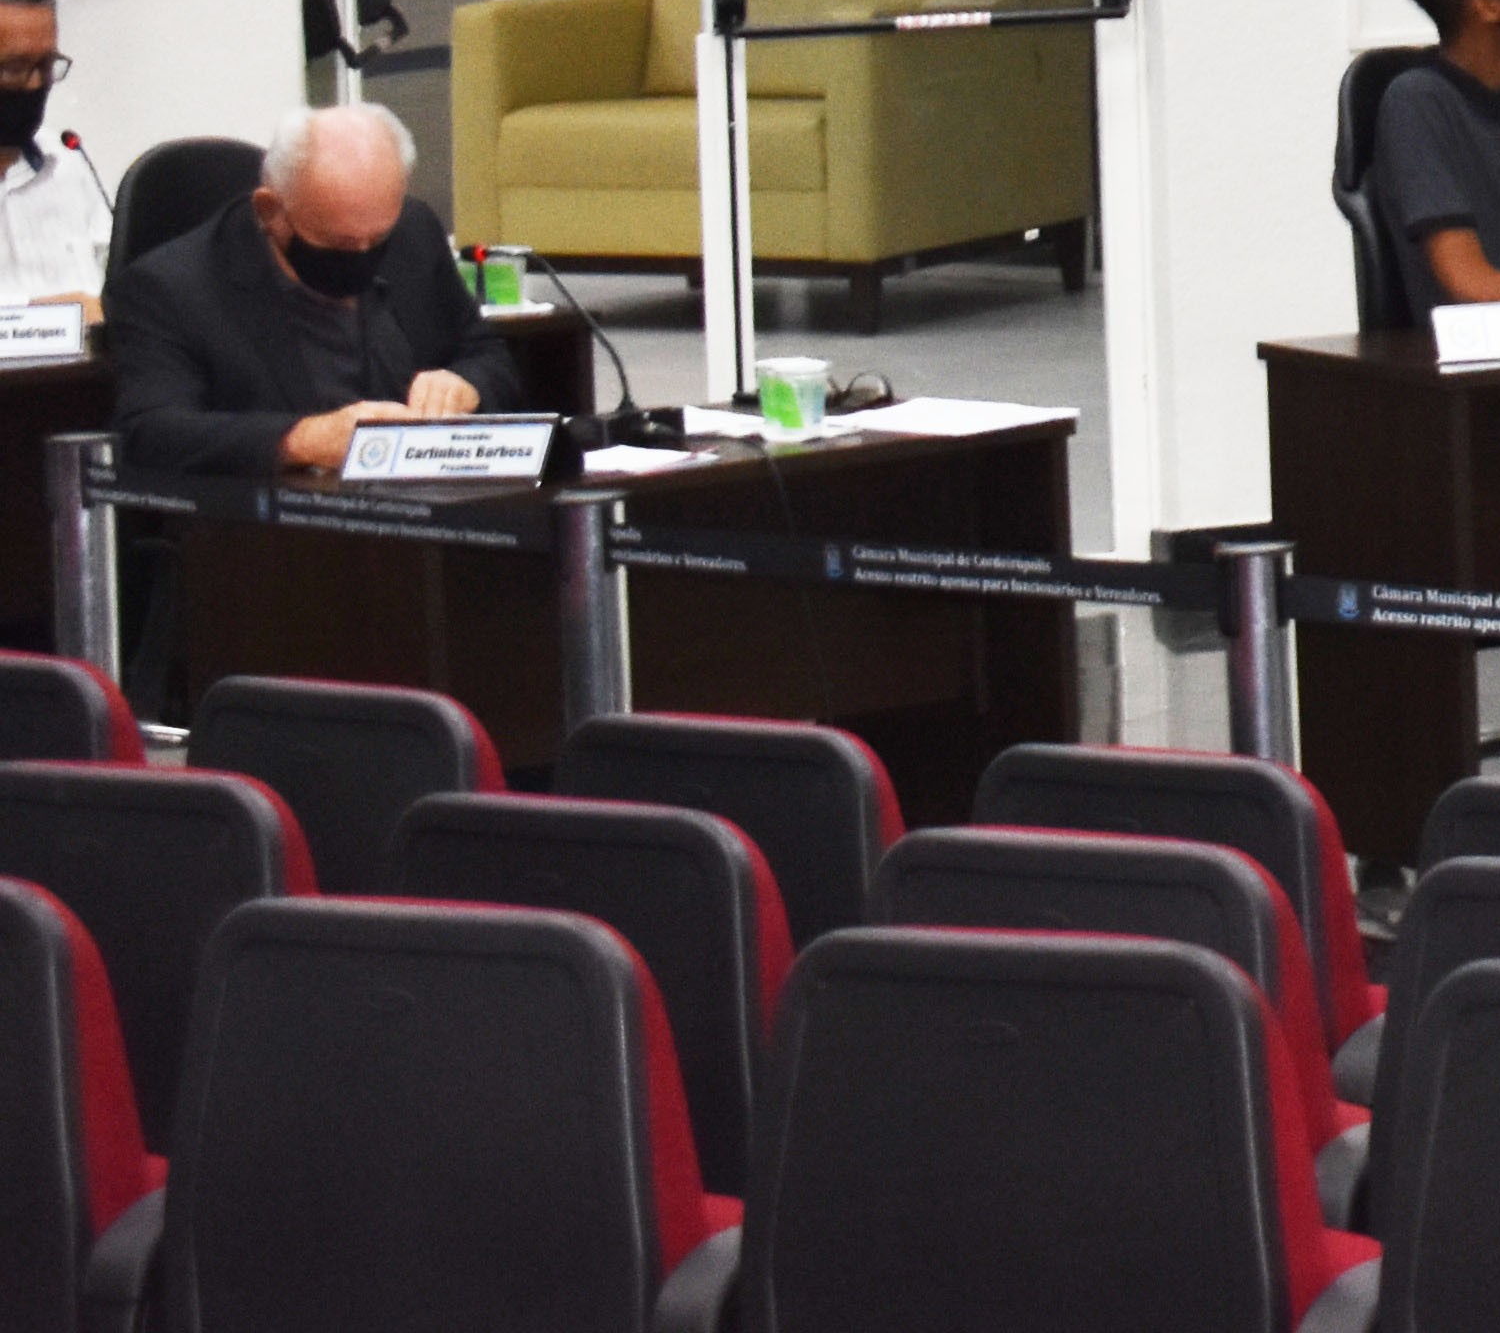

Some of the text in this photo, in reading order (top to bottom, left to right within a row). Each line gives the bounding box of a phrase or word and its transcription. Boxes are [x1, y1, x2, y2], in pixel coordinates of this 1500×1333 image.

[1372, 584, 1424, 602] Câmara
[1426, 588, 1493, 609] Municipal
[1372, 608, 1418, 625] Acesso
[1421, 612, 1471, 629] restrito
